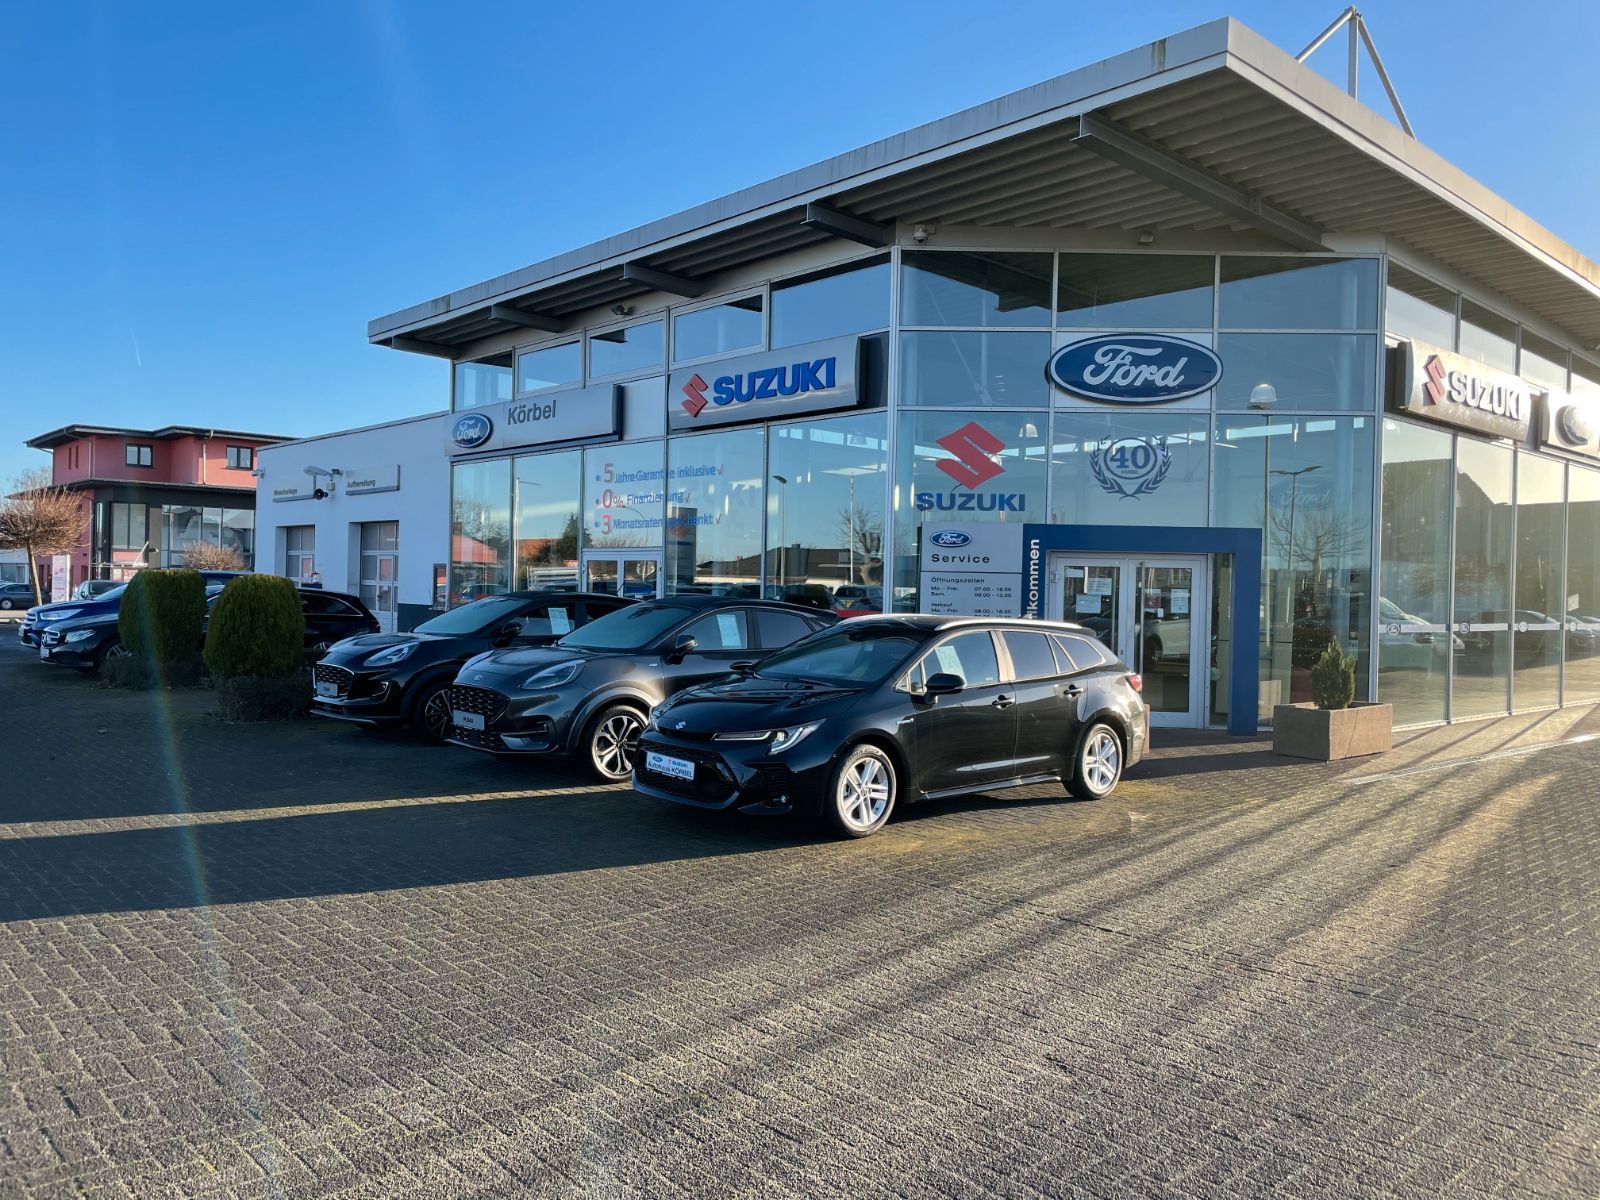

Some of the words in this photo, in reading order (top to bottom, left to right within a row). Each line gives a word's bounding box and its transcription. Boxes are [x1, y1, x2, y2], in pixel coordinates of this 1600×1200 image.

[1083, 344, 1188, 387] Ford
[713, 357, 837, 406] SUZUKI
[507, 399, 557, 426] Körbel
[456, 419, 482, 441] Ford
[1110, 445, 1151, 470] 40
[603, 463, 614, 483] 5
[636, 467, 675, 481] Garante
[677, 463, 716, 479] inklusive
[915, 492, 1026, 512] SUZUKI
[602, 514, 612, 535] 3
[613, 517, 663, 529] Monatsraten
[938, 531, 965, 544] Ford
[931, 553, 990, 564] Service
[931, 576, 985, 584] Öffnungszeiten
